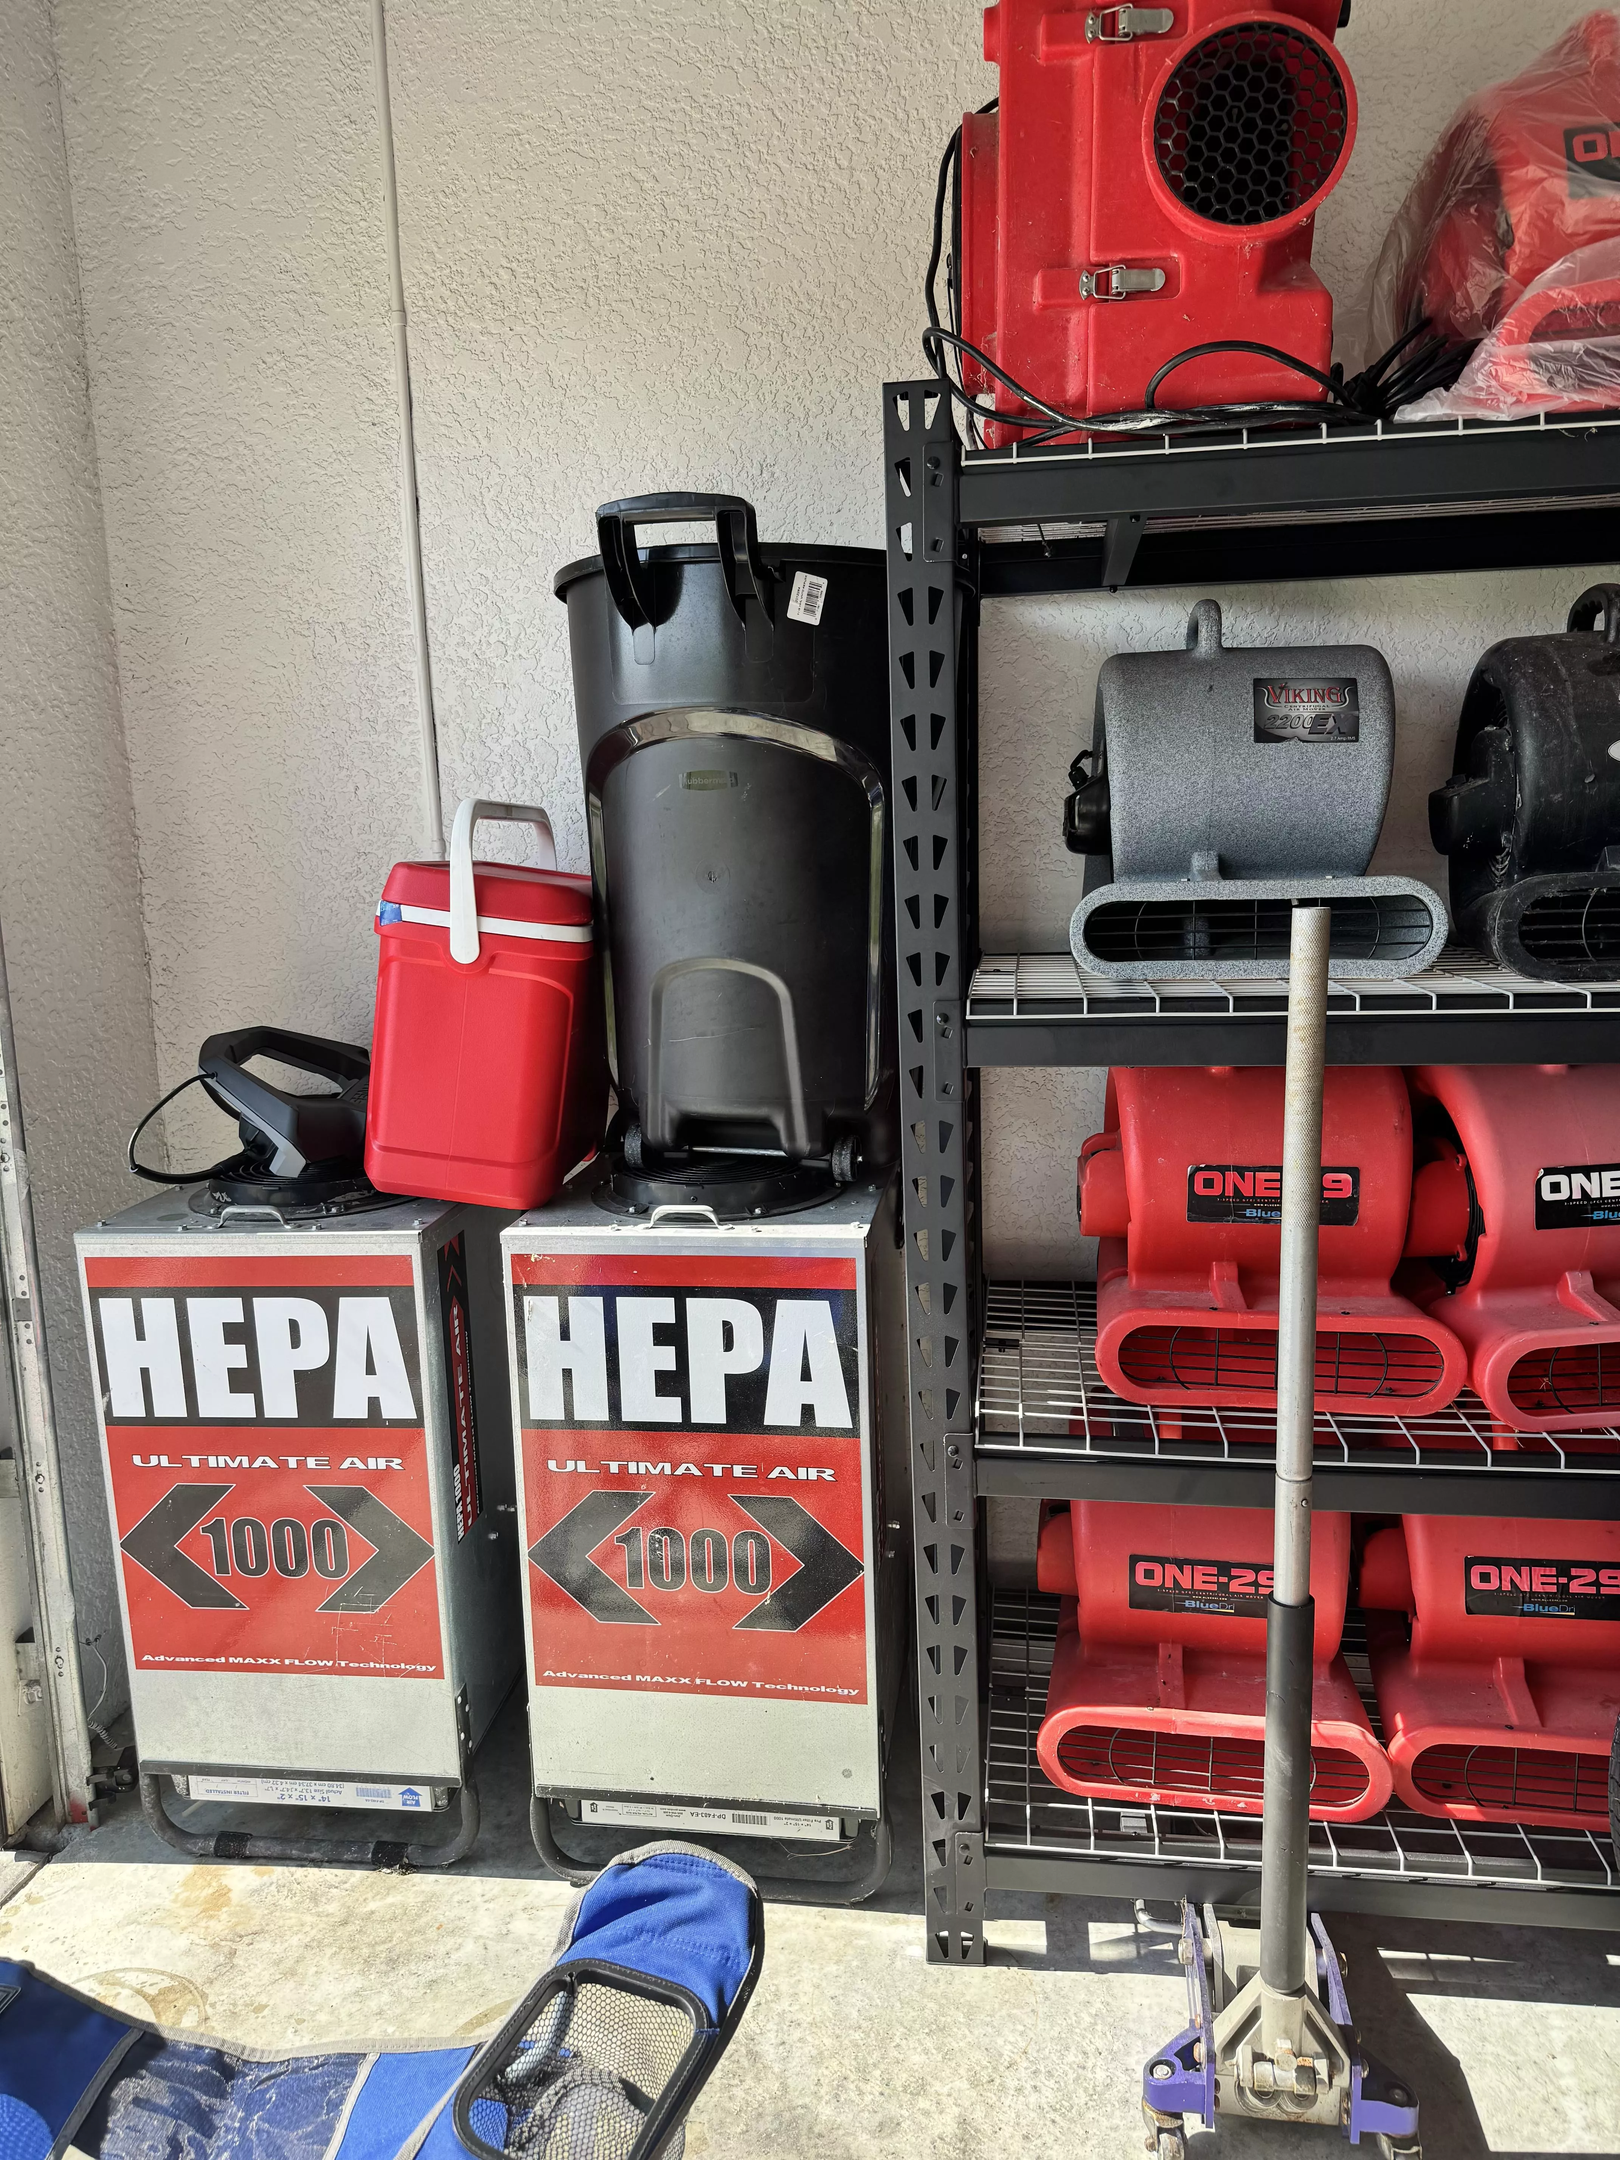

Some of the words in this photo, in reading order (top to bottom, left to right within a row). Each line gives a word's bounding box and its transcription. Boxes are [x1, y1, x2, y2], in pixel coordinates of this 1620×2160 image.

[1267, 682, 1343, 704] VIKING
[1194, 1171, 1353, 1199] ONE9
[1245, 1209, 1282, 1218] Blue
[453, 1304, 462, 1357] AIR
[99, 1297, 417, 1419] HEPA
[523, 1296, 853, 1428] HEPA
[457, 1363, 473, 1527] ULTIMATE
[132, 1455, 331, 1470] ULTIMATE
[338, 1456, 405, 1471] AIR
[547, 1459, 759, 1479] ULTIMATE
[766, 1465, 838, 1482] AIR
[453, 1463, 463, 1503] 1000
[455, 1501, 465, 1542] HEPA
[200, 1517, 350, 1580] 1000
[614, 1527, 772, 1596] 1000
[1470, 1565, 1620, 1595] ONE-29
[1184, 1600, 1235, 1610] BlueDri
[1523, 1603, 1575, 1612] BlueDri
[141, 1654, 226, 1664] Advanced
[228, 1656, 282, 1665] MAXX
[284, 1658, 334, 1668] FLOW
[336, 1660, 437, 1672] Technology
[542, 1670, 632, 1682] Advanced
[635, 1674, 692, 1684] MAXX
[695, 1677, 749, 1688] FLOW
[752, 1680, 860, 1696] Technology
